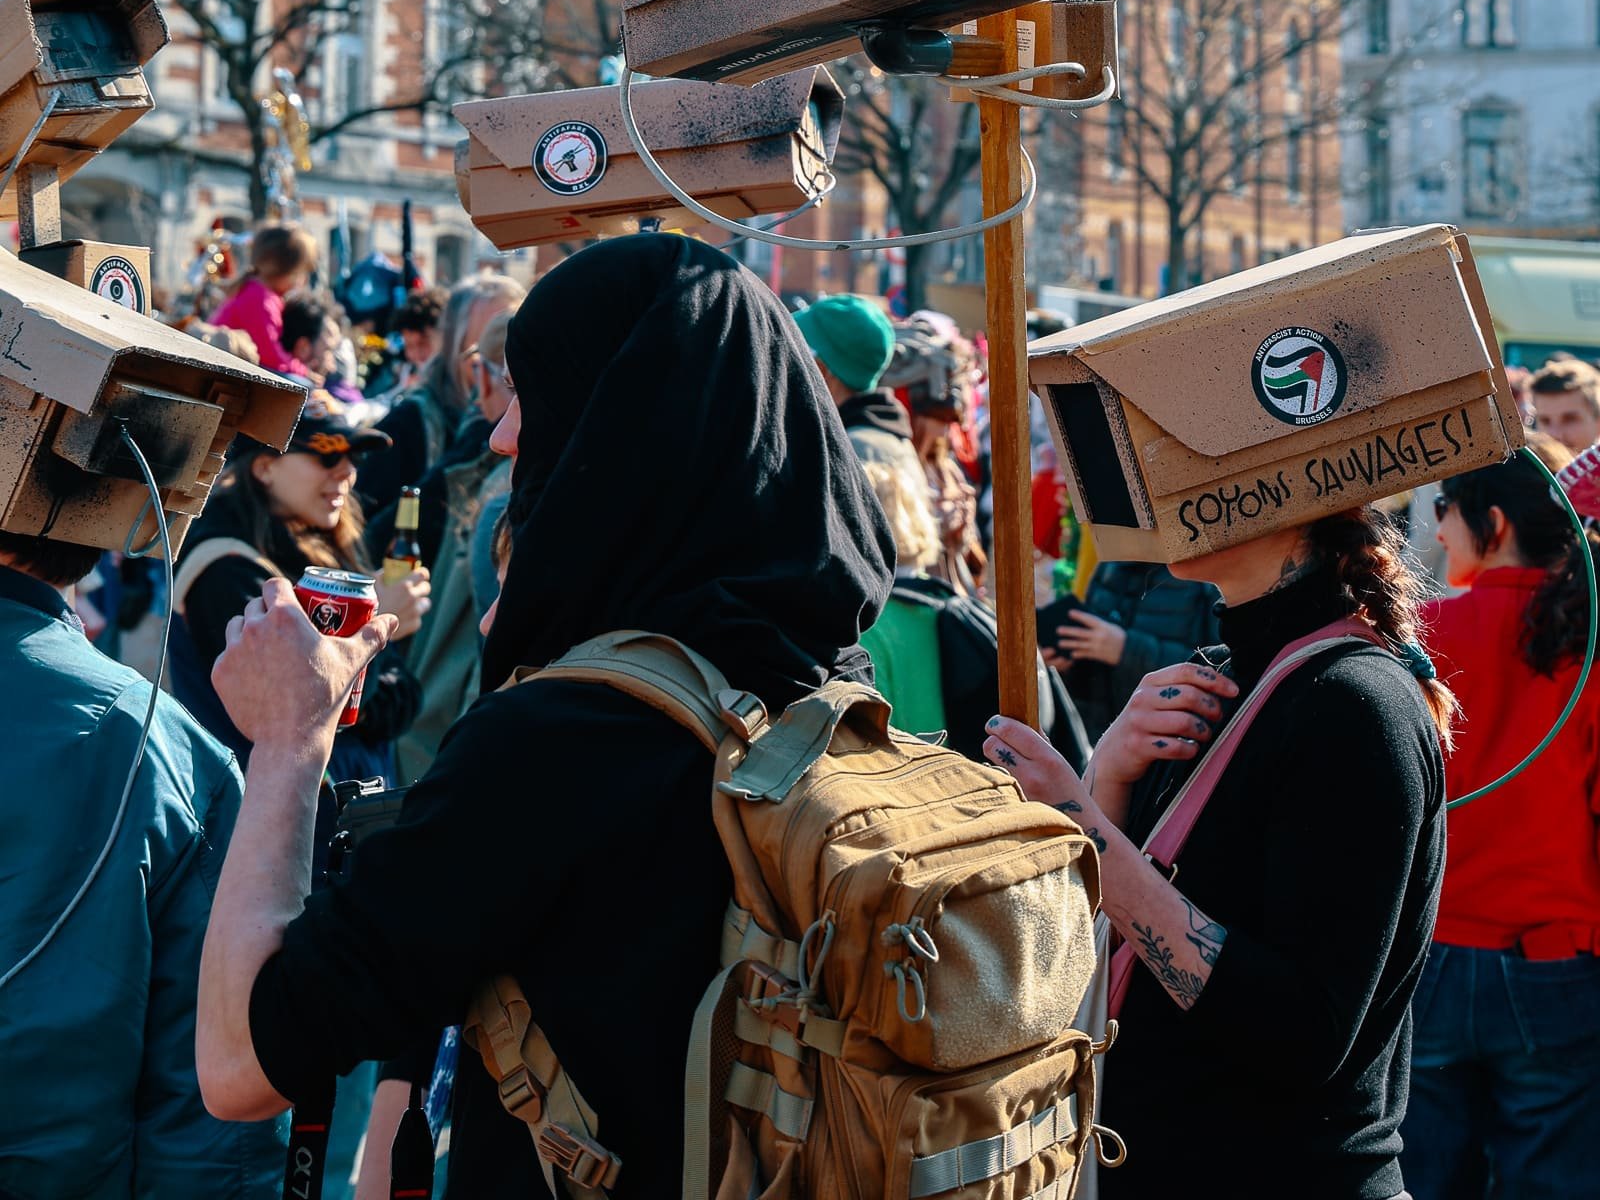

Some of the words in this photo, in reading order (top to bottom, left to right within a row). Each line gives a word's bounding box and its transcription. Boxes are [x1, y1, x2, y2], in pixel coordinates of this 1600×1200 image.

[1255, 328, 1292, 362] ANTIFASCIST
[1295, 328, 1324, 343] ACTION
[1295, 406, 1333, 425] BRUSSELS
[1178, 470, 1292, 542] SOYONS
